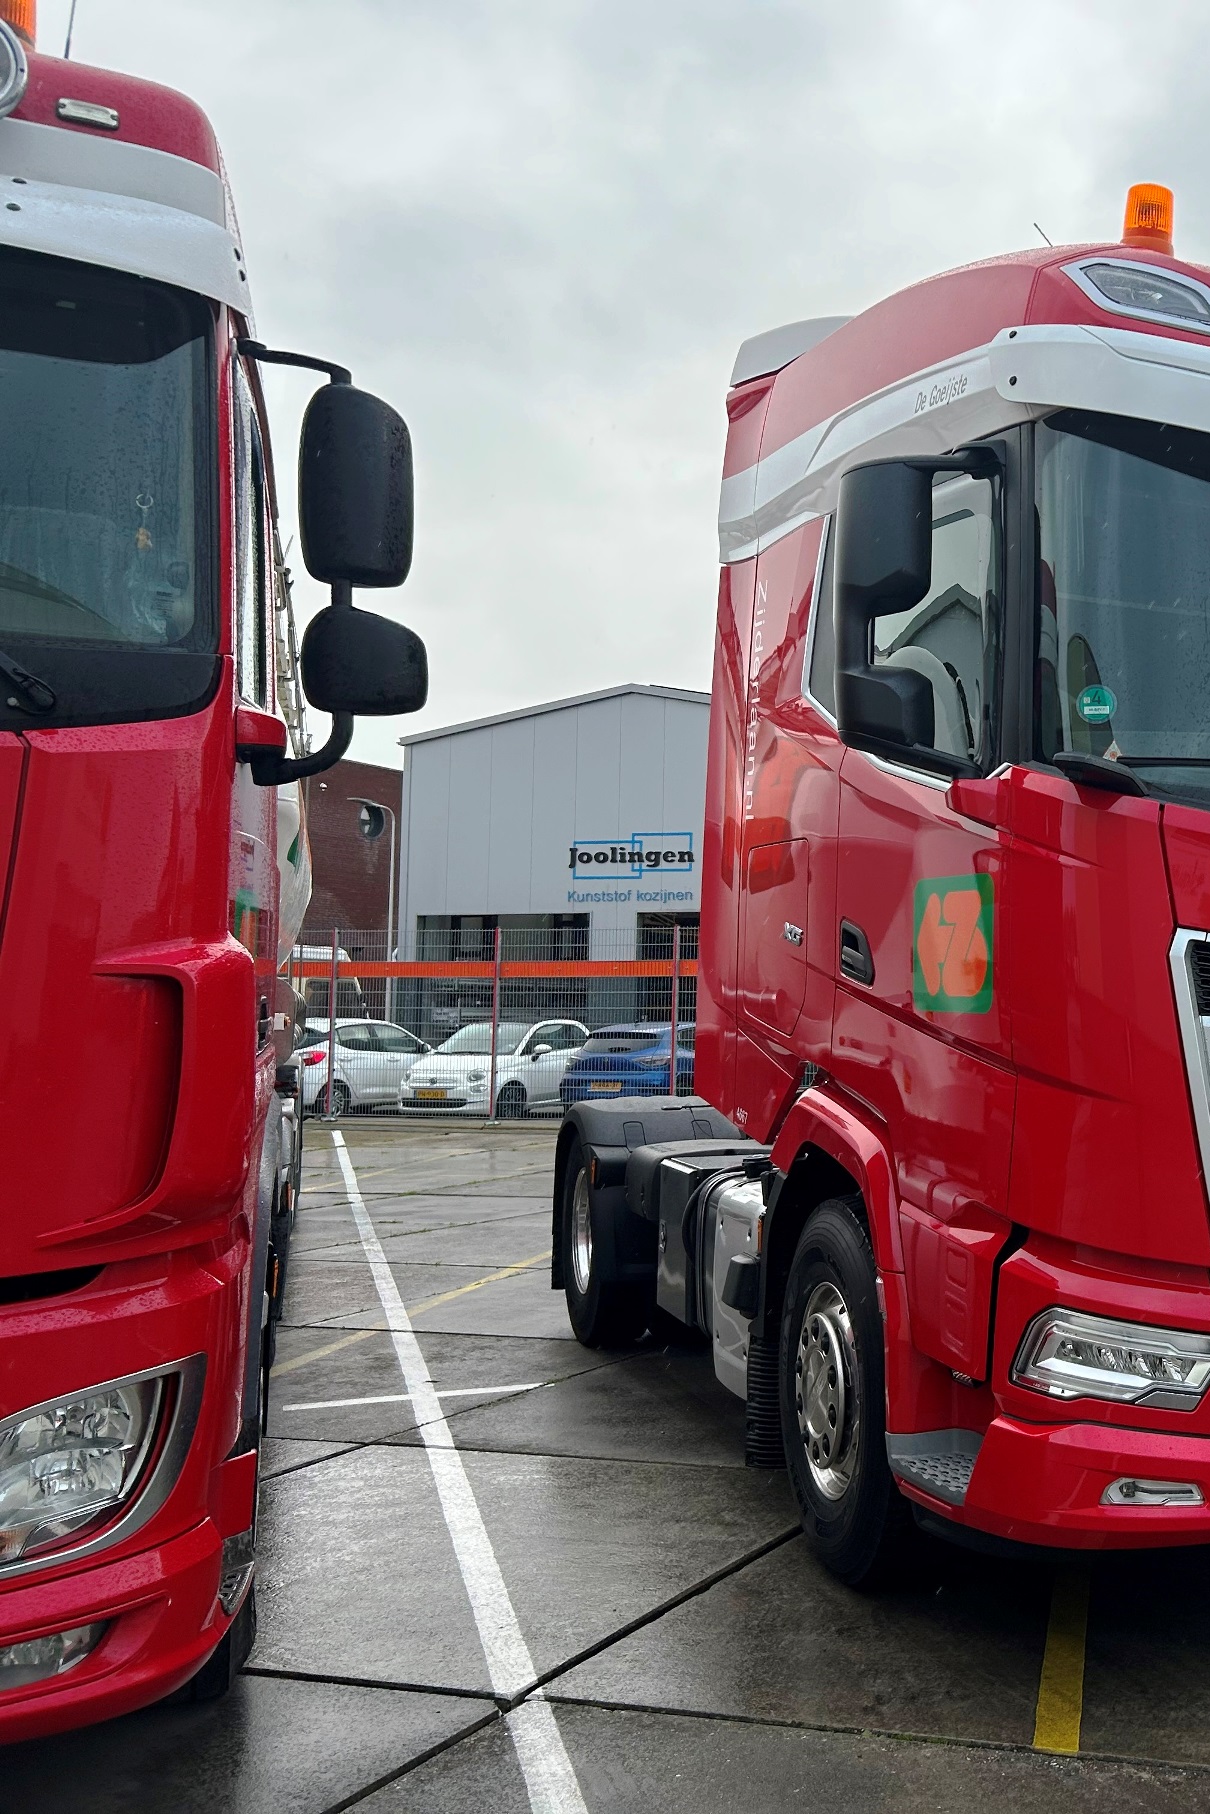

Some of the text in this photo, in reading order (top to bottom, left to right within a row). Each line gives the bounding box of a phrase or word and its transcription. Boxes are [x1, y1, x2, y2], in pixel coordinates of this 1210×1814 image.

[914, 391, 927, 414] De
[568, 847, 695, 869] Joolingen
[567, 889, 693, 904] Kunststof kozijnen
